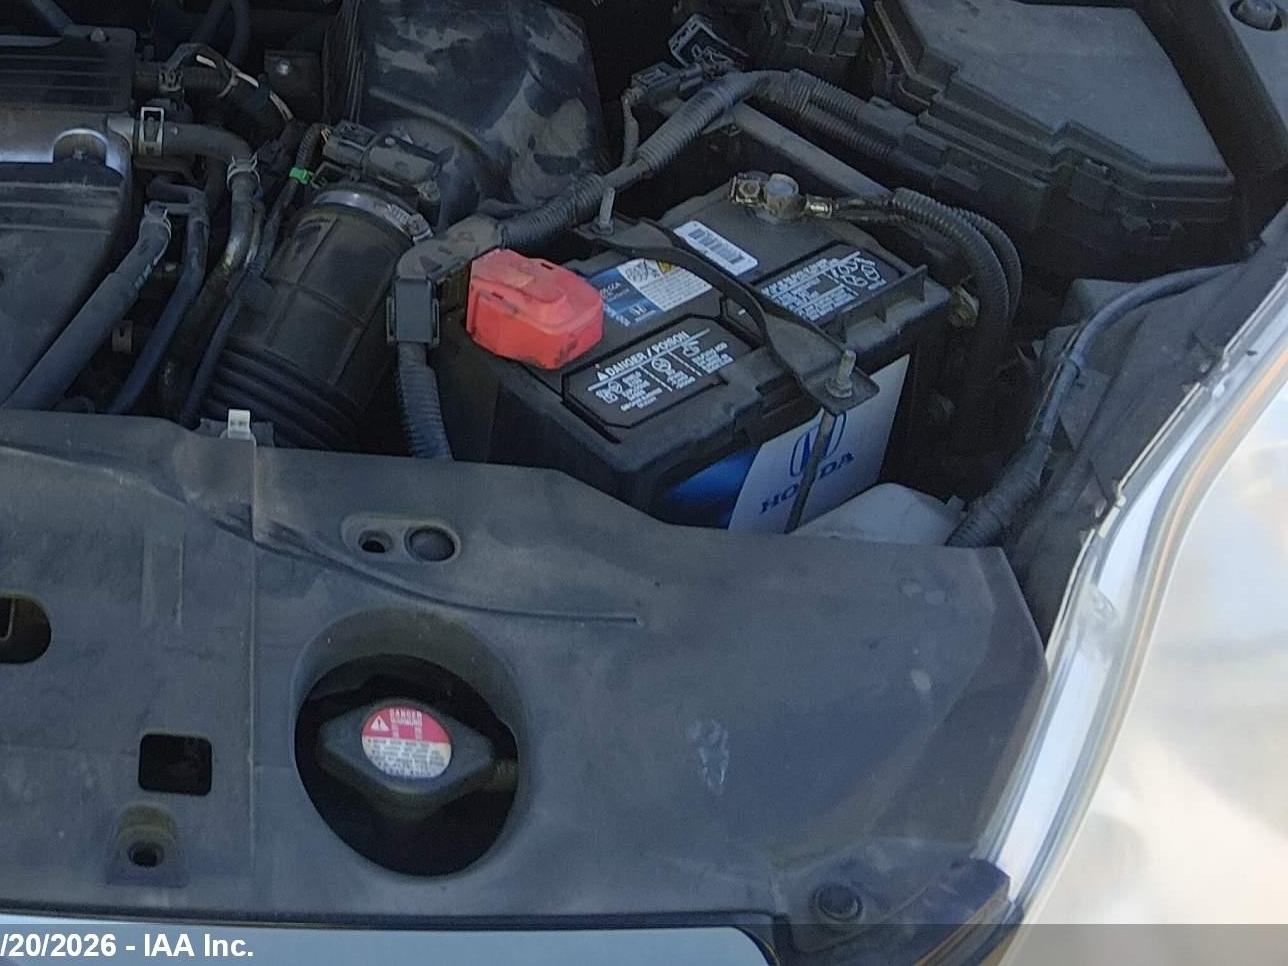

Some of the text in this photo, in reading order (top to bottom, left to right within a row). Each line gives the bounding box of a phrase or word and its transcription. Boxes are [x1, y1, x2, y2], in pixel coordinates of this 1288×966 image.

[605, 351, 648, 378] DANGER
[652, 331, 691, 354] POISON
[759, 452, 855, 515] HODA
